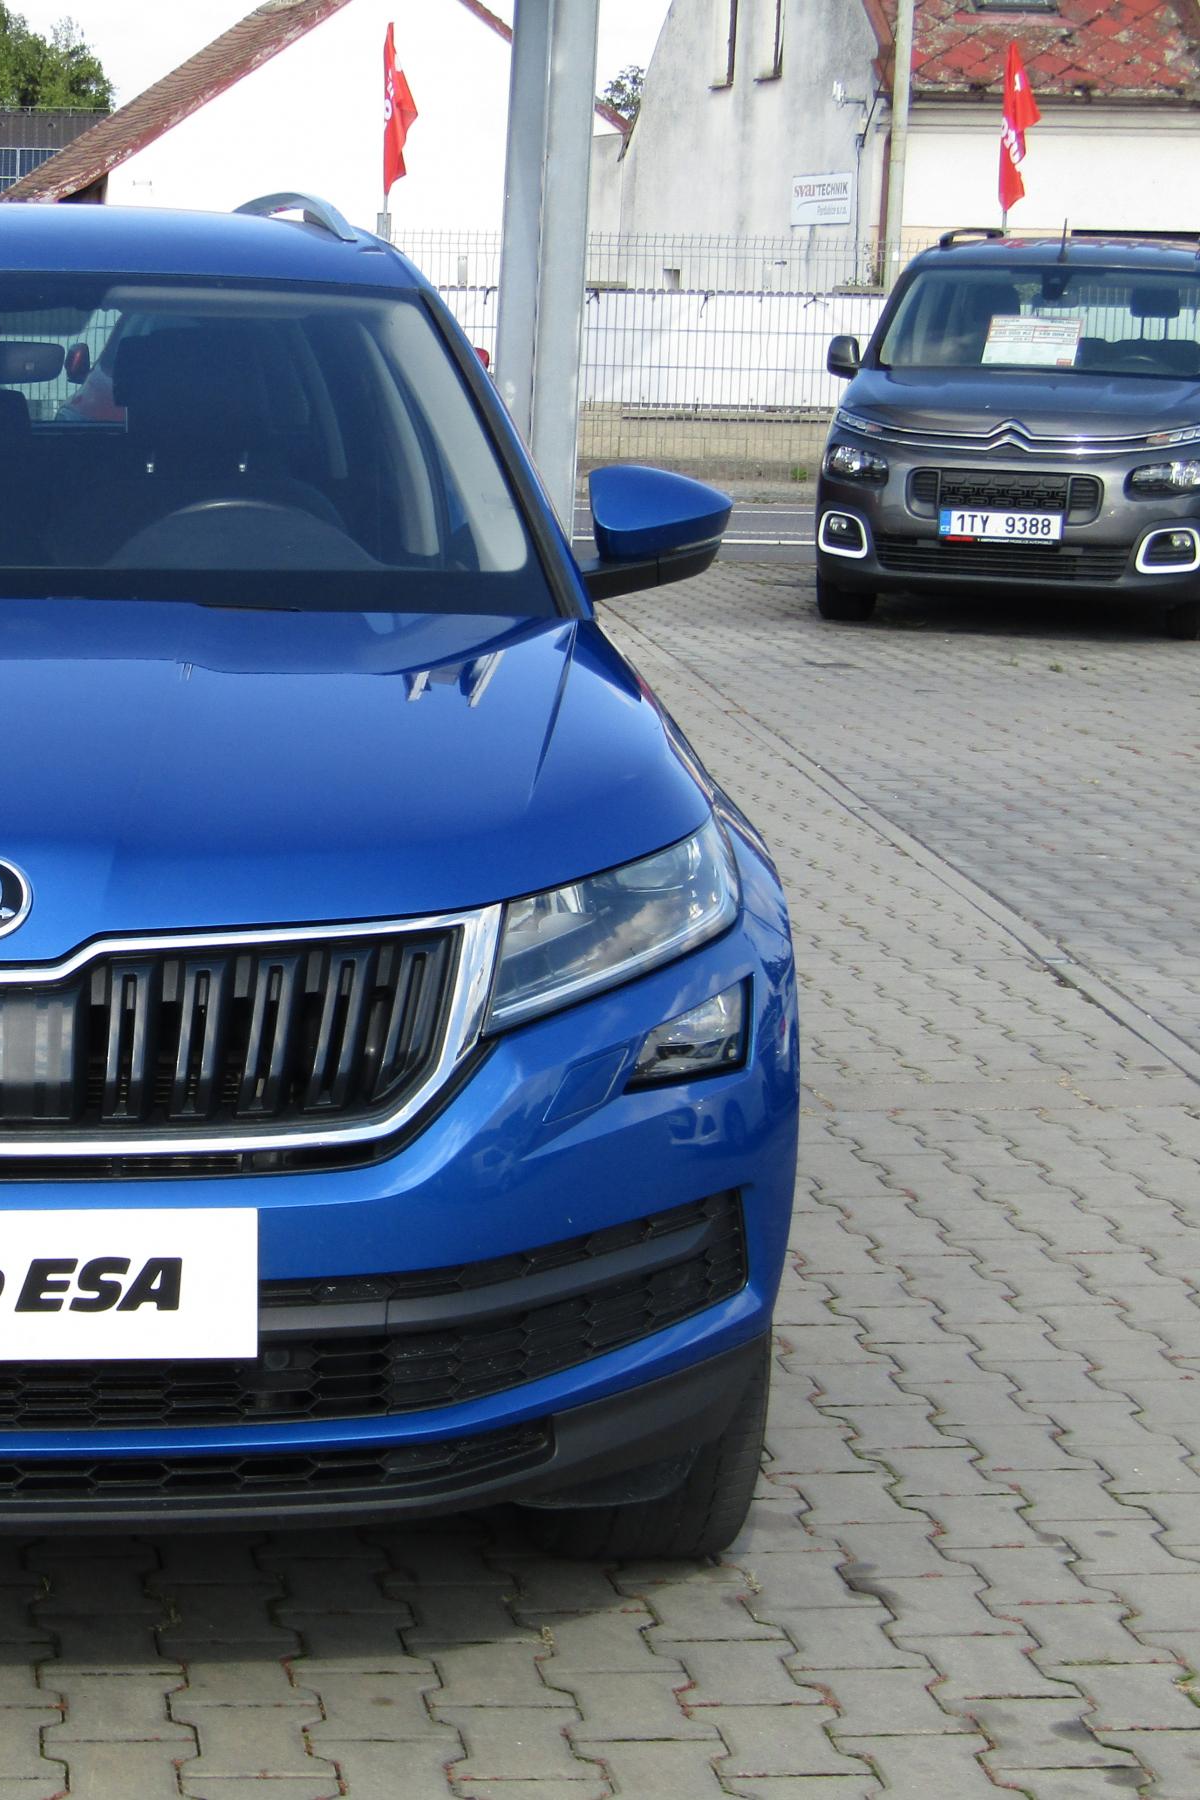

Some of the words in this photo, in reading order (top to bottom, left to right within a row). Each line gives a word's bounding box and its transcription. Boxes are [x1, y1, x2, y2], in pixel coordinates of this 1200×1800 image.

[957, 514, 989, 533] 1TY
[1005, 516, 1051, 536] 9388
[14, 1256, 183, 1313] ESA
